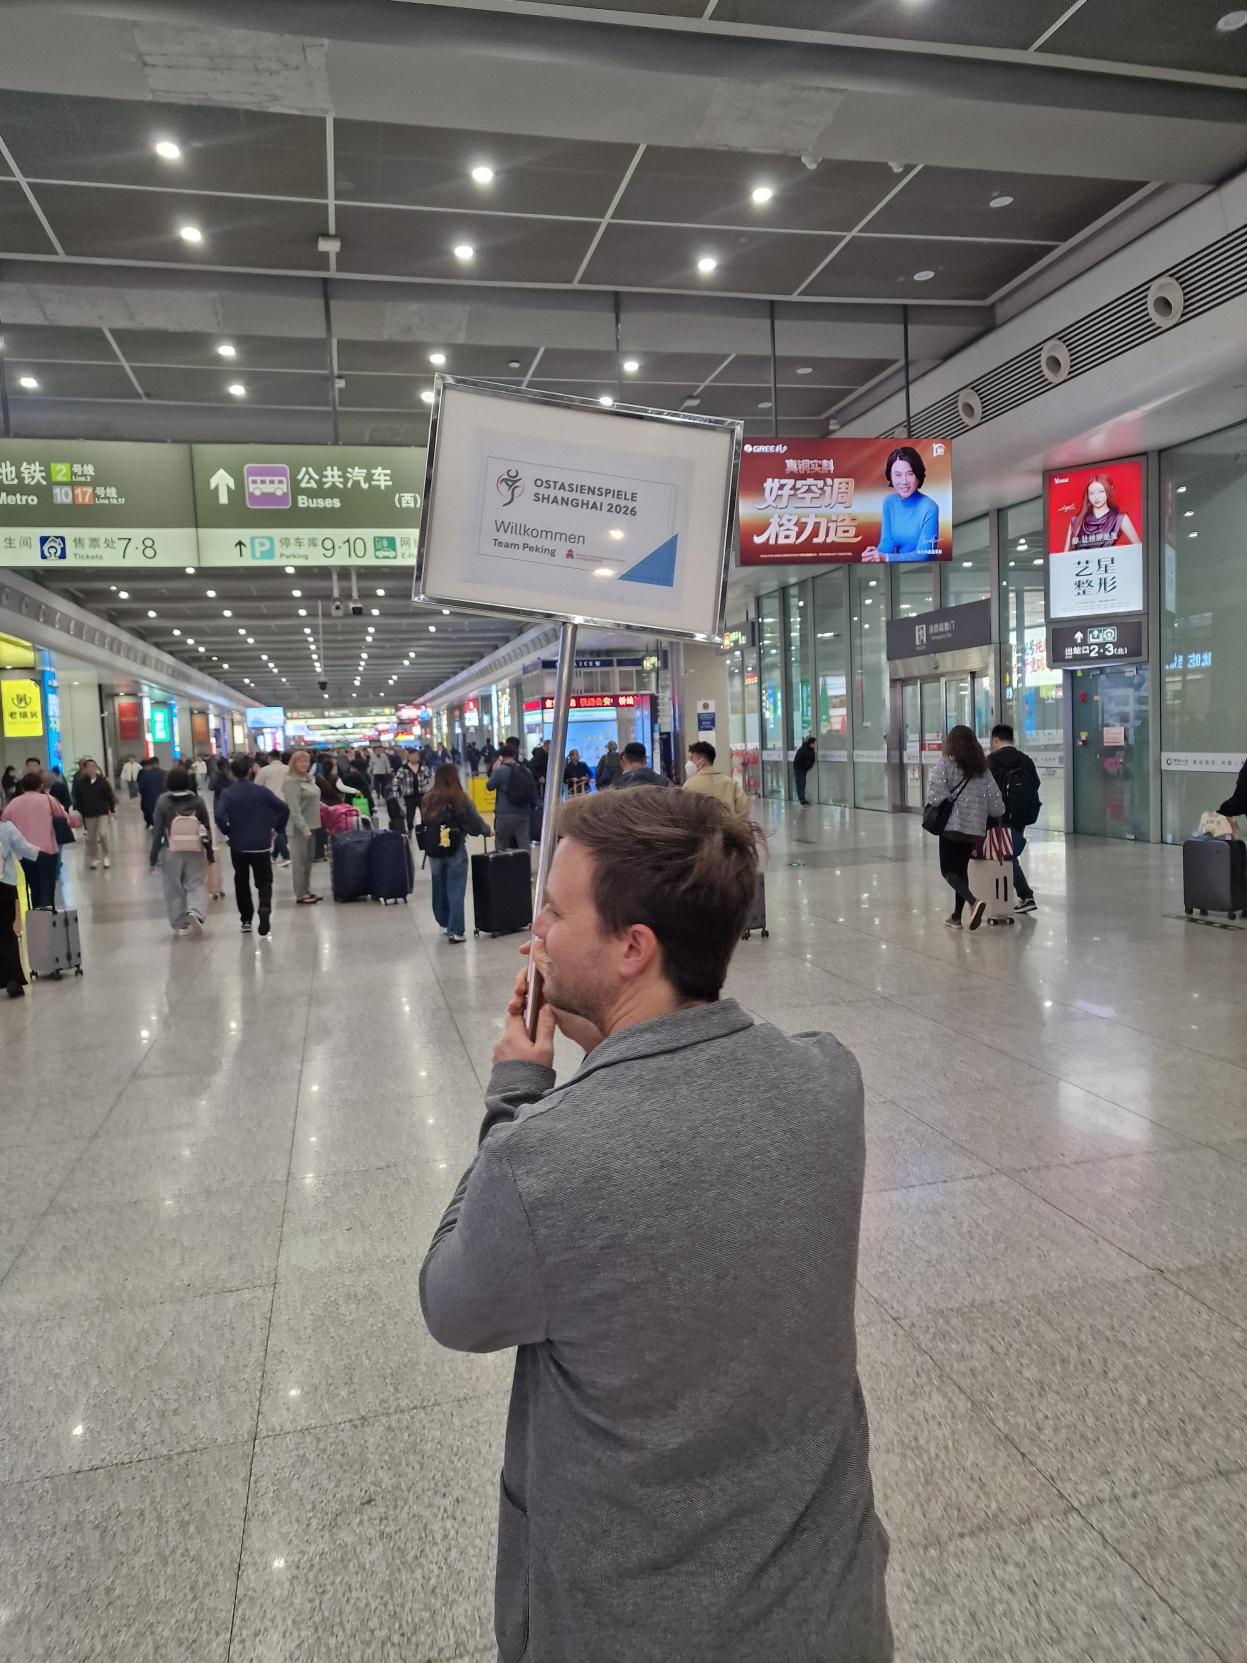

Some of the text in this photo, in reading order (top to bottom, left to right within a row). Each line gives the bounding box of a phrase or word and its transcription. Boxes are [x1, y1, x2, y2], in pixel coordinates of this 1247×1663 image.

[0, 460, 47, 485] 地铁
[296, 466, 393, 490] 公共汽车
[394, 493, 421, 508] (西)
[534, 478, 638, 502] OSTASIENSPIELE
[754, 477, 855, 510] 好空调
[297, 495, 341, 508] Buses
[533, 492, 638, 516] SHANGHAI 2026
[494, 519, 586, 545] Willkommen
[753, 513, 862, 545] 格力造
[279, 537, 319, 549] 停车库
[492, 538, 557, 557] Team Peking
[73, 552, 103, 560] Tickets
[280, 552, 309, 560] Parking
[1073, 556, 1116, 577] 艺星
[1073, 576, 1117, 597] 整形
